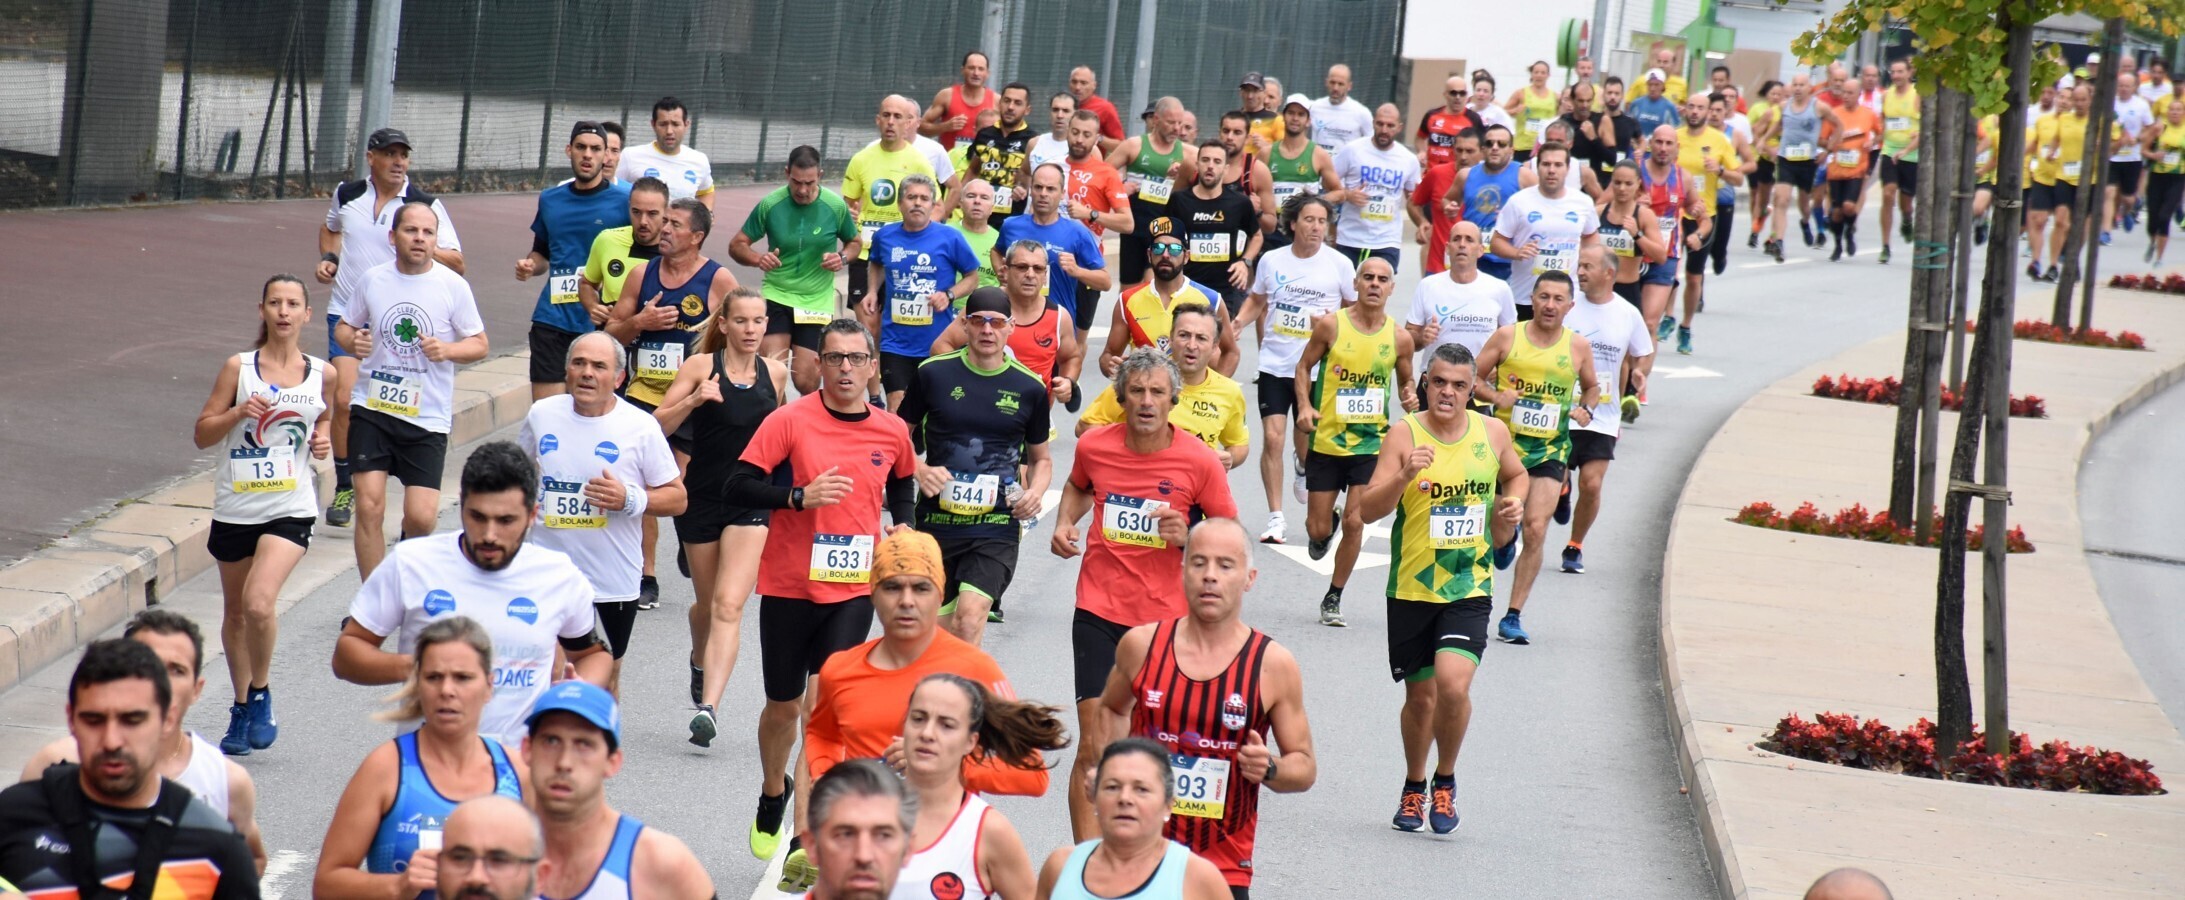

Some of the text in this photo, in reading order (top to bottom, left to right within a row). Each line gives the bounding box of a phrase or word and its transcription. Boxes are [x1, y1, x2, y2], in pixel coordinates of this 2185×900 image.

[1150, 184, 1167, 197] 560
[1369, 203, 1387, 215] 621
[1199, 242, 1220, 254] 605
[1606, 237, 1626, 249] 628
[1543, 258, 1563, 270] 482
[561, 278, 577, 292] 42
[1285, 284, 1326, 299] fisiojoane
[396, 306, 417, 316] CLUBE
[900, 302, 922, 317] 647
[1283, 313, 1305, 329] 354
[1450, 313, 1493, 325] fisiojoane
[650, 353, 667, 368] 38
[1340, 368, 1387, 386] Davitex
[379, 385, 408, 405] 826
[1516, 378, 1567, 397] Davitex
[1348, 400, 1373, 413] 865
[1522, 411, 1548, 428] 860
[252, 461, 275, 479] 13
[251, 481, 283, 489] BOLAMA
[1431, 479, 1491, 499] Davitex
[952, 485, 983, 504] 544
[557, 496, 591, 516] 584
[953, 503, 983, 513] BOLAMA
[560, 518, 594, 526] BOLAMA
[1117, 510, 1153, 533] 630
[1444, 519, 1474, 536] 872
[1119, 532, 1154, 544] BOLAMA
[827, 550, 859, 569] 633
[829, 570, 860, 579] BOLAMA
[493, 667, 535, 688] OANE
[1177, 774, 1207, 800] 93
[1171, 801, 1207, 812] OLAMA
[397, 822, 419, 835] STA
